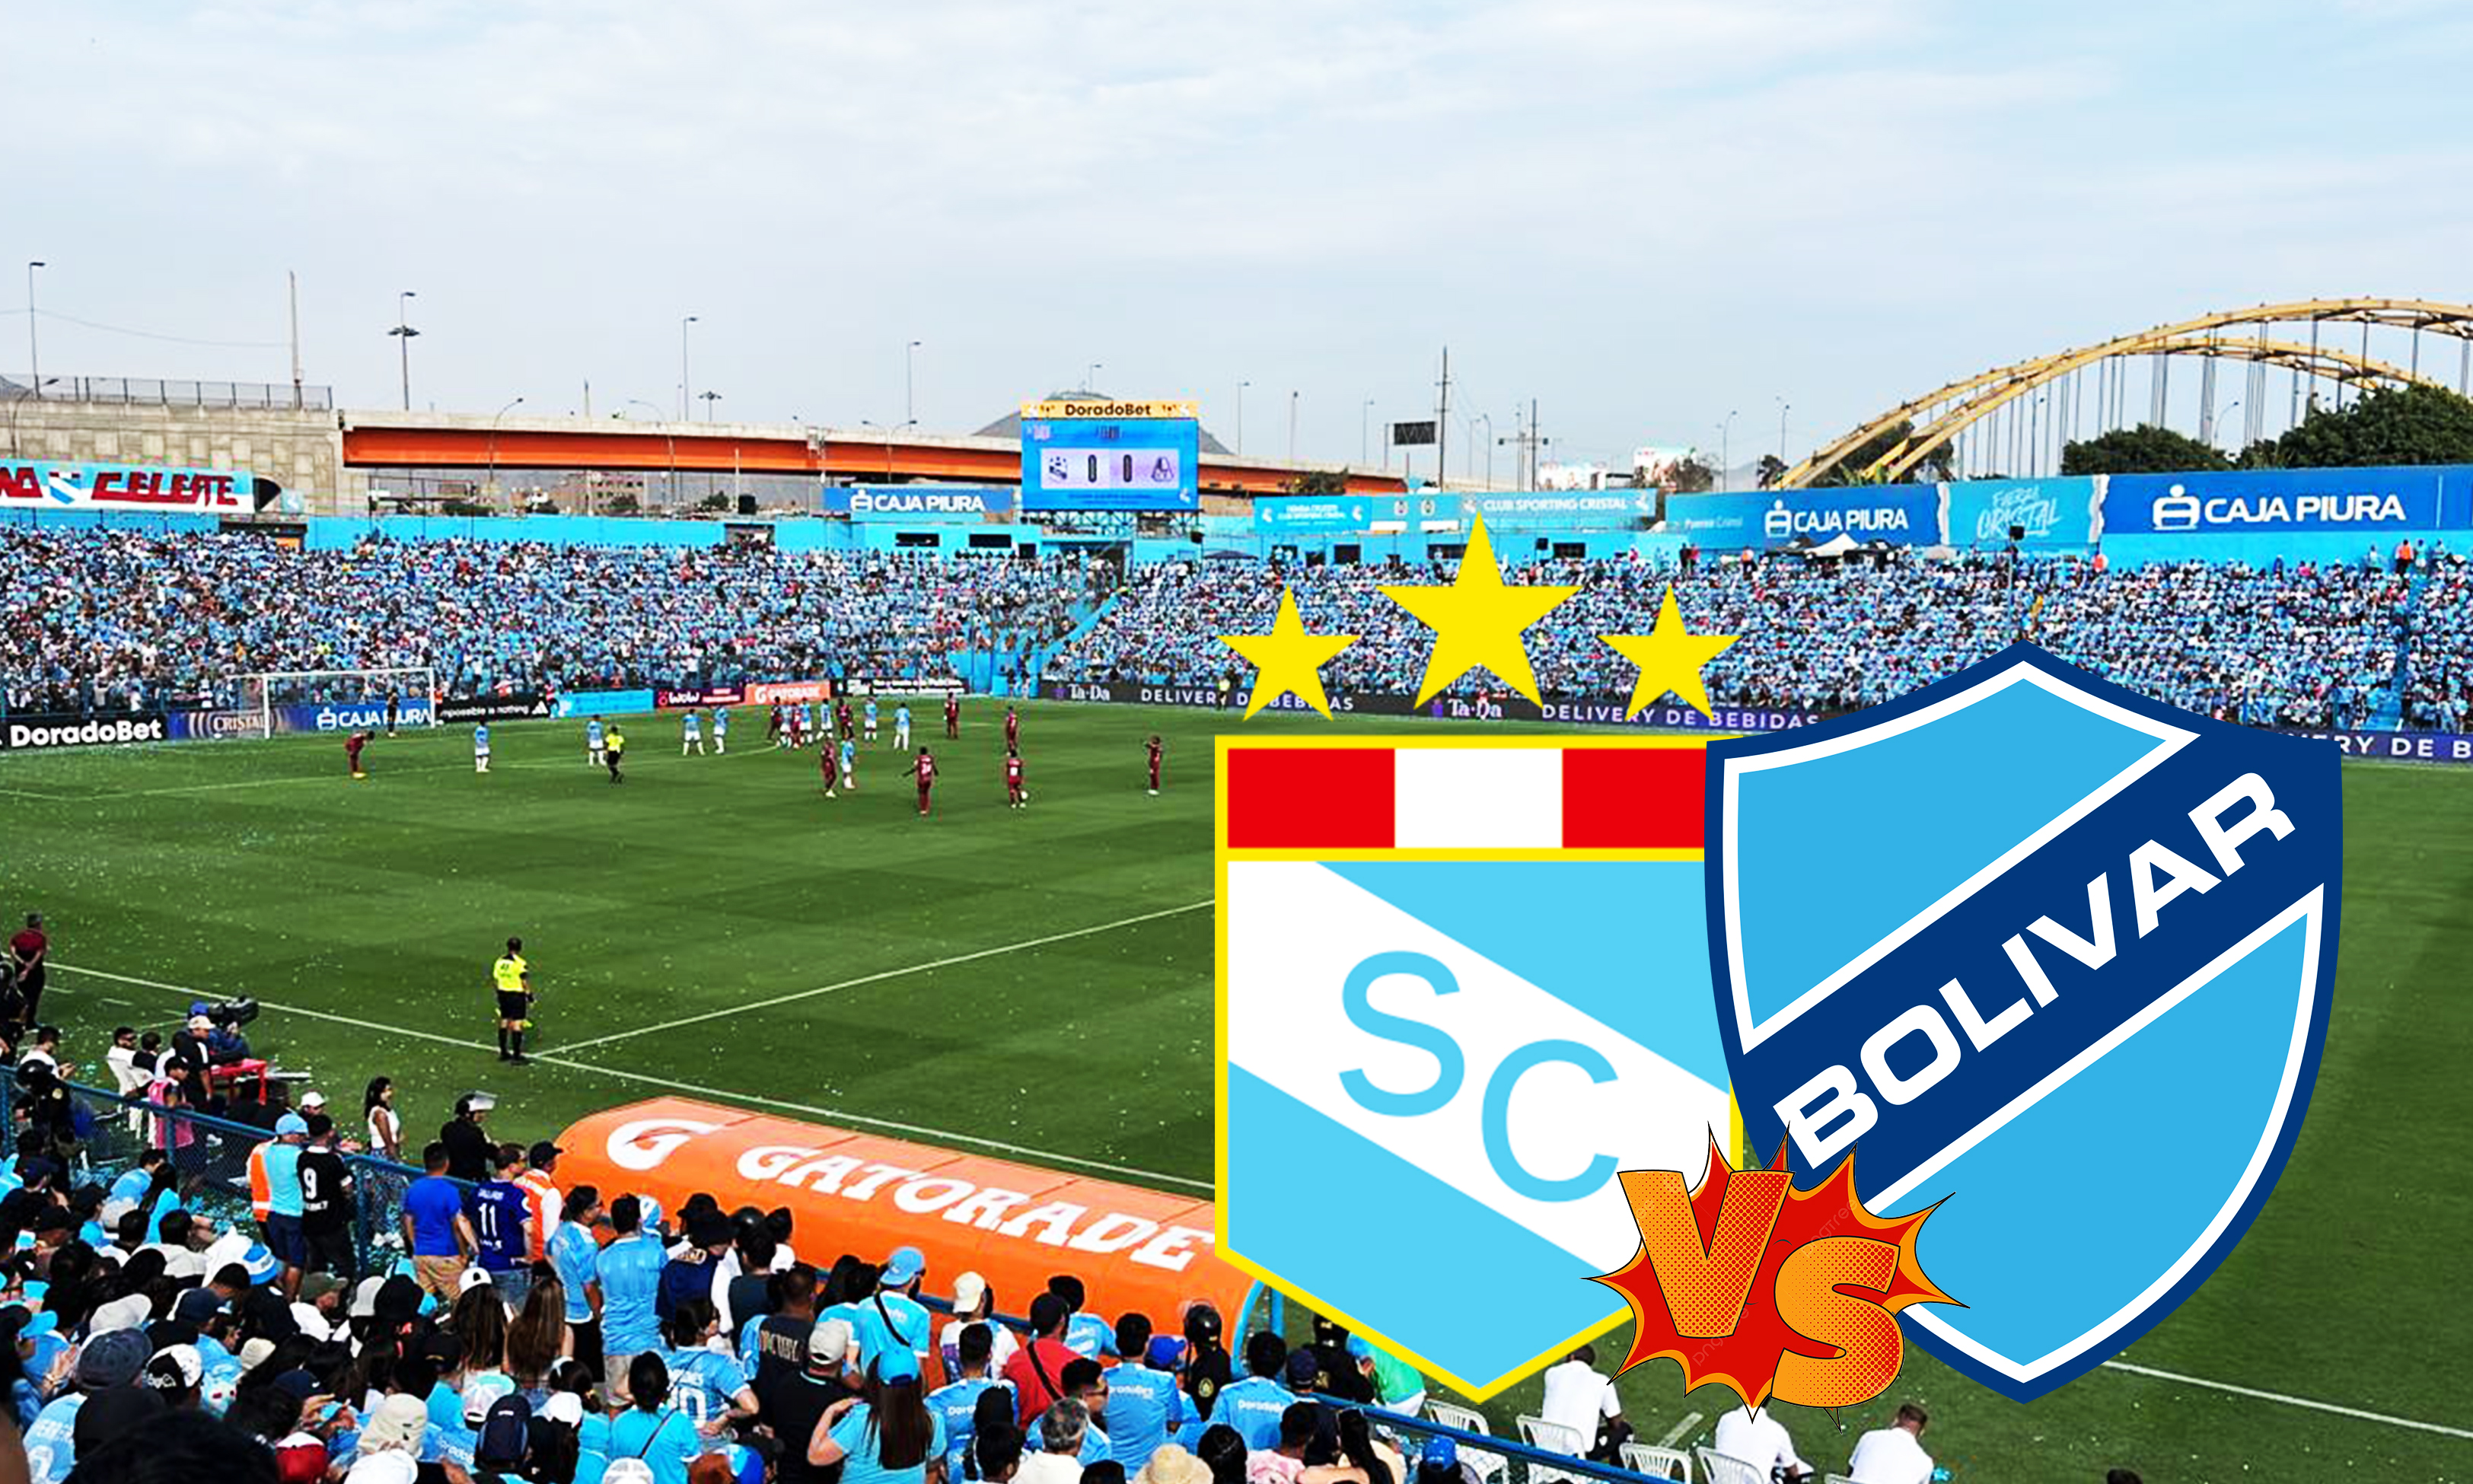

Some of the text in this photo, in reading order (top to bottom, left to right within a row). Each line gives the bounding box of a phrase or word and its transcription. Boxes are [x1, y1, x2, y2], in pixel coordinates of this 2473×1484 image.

[1064, 403, 1152, 417] DoradoBet
[874, 494, 986, 511] CAJA PIURA
[1483, 497, 1628, 511] CLUB SPORTING CRISTAL
[2204, 494, 2407, 524] CAJA PIURA
[1793, 508, 1909, 533] CAJA PIURA
[1141, 687, 1218, 705] DELIVER
[1269, 693, 1354, 711] BEBAS
[338, 708, 432, 727] CAJA PURA
[441, 706, 486, 718] mpossible
[1665, 709, 1697, 726] DE
[1708, 712, 1819, 730] BEBIDAS
[10, 718, 162, 747] DoradoBet
[2391, 737, 2434, 757] DE
[303, 1167, 317, 1200] 9
[736, 1145, 1215, 1271] GATORADE
[478, 1202, 498, 1238] 11
